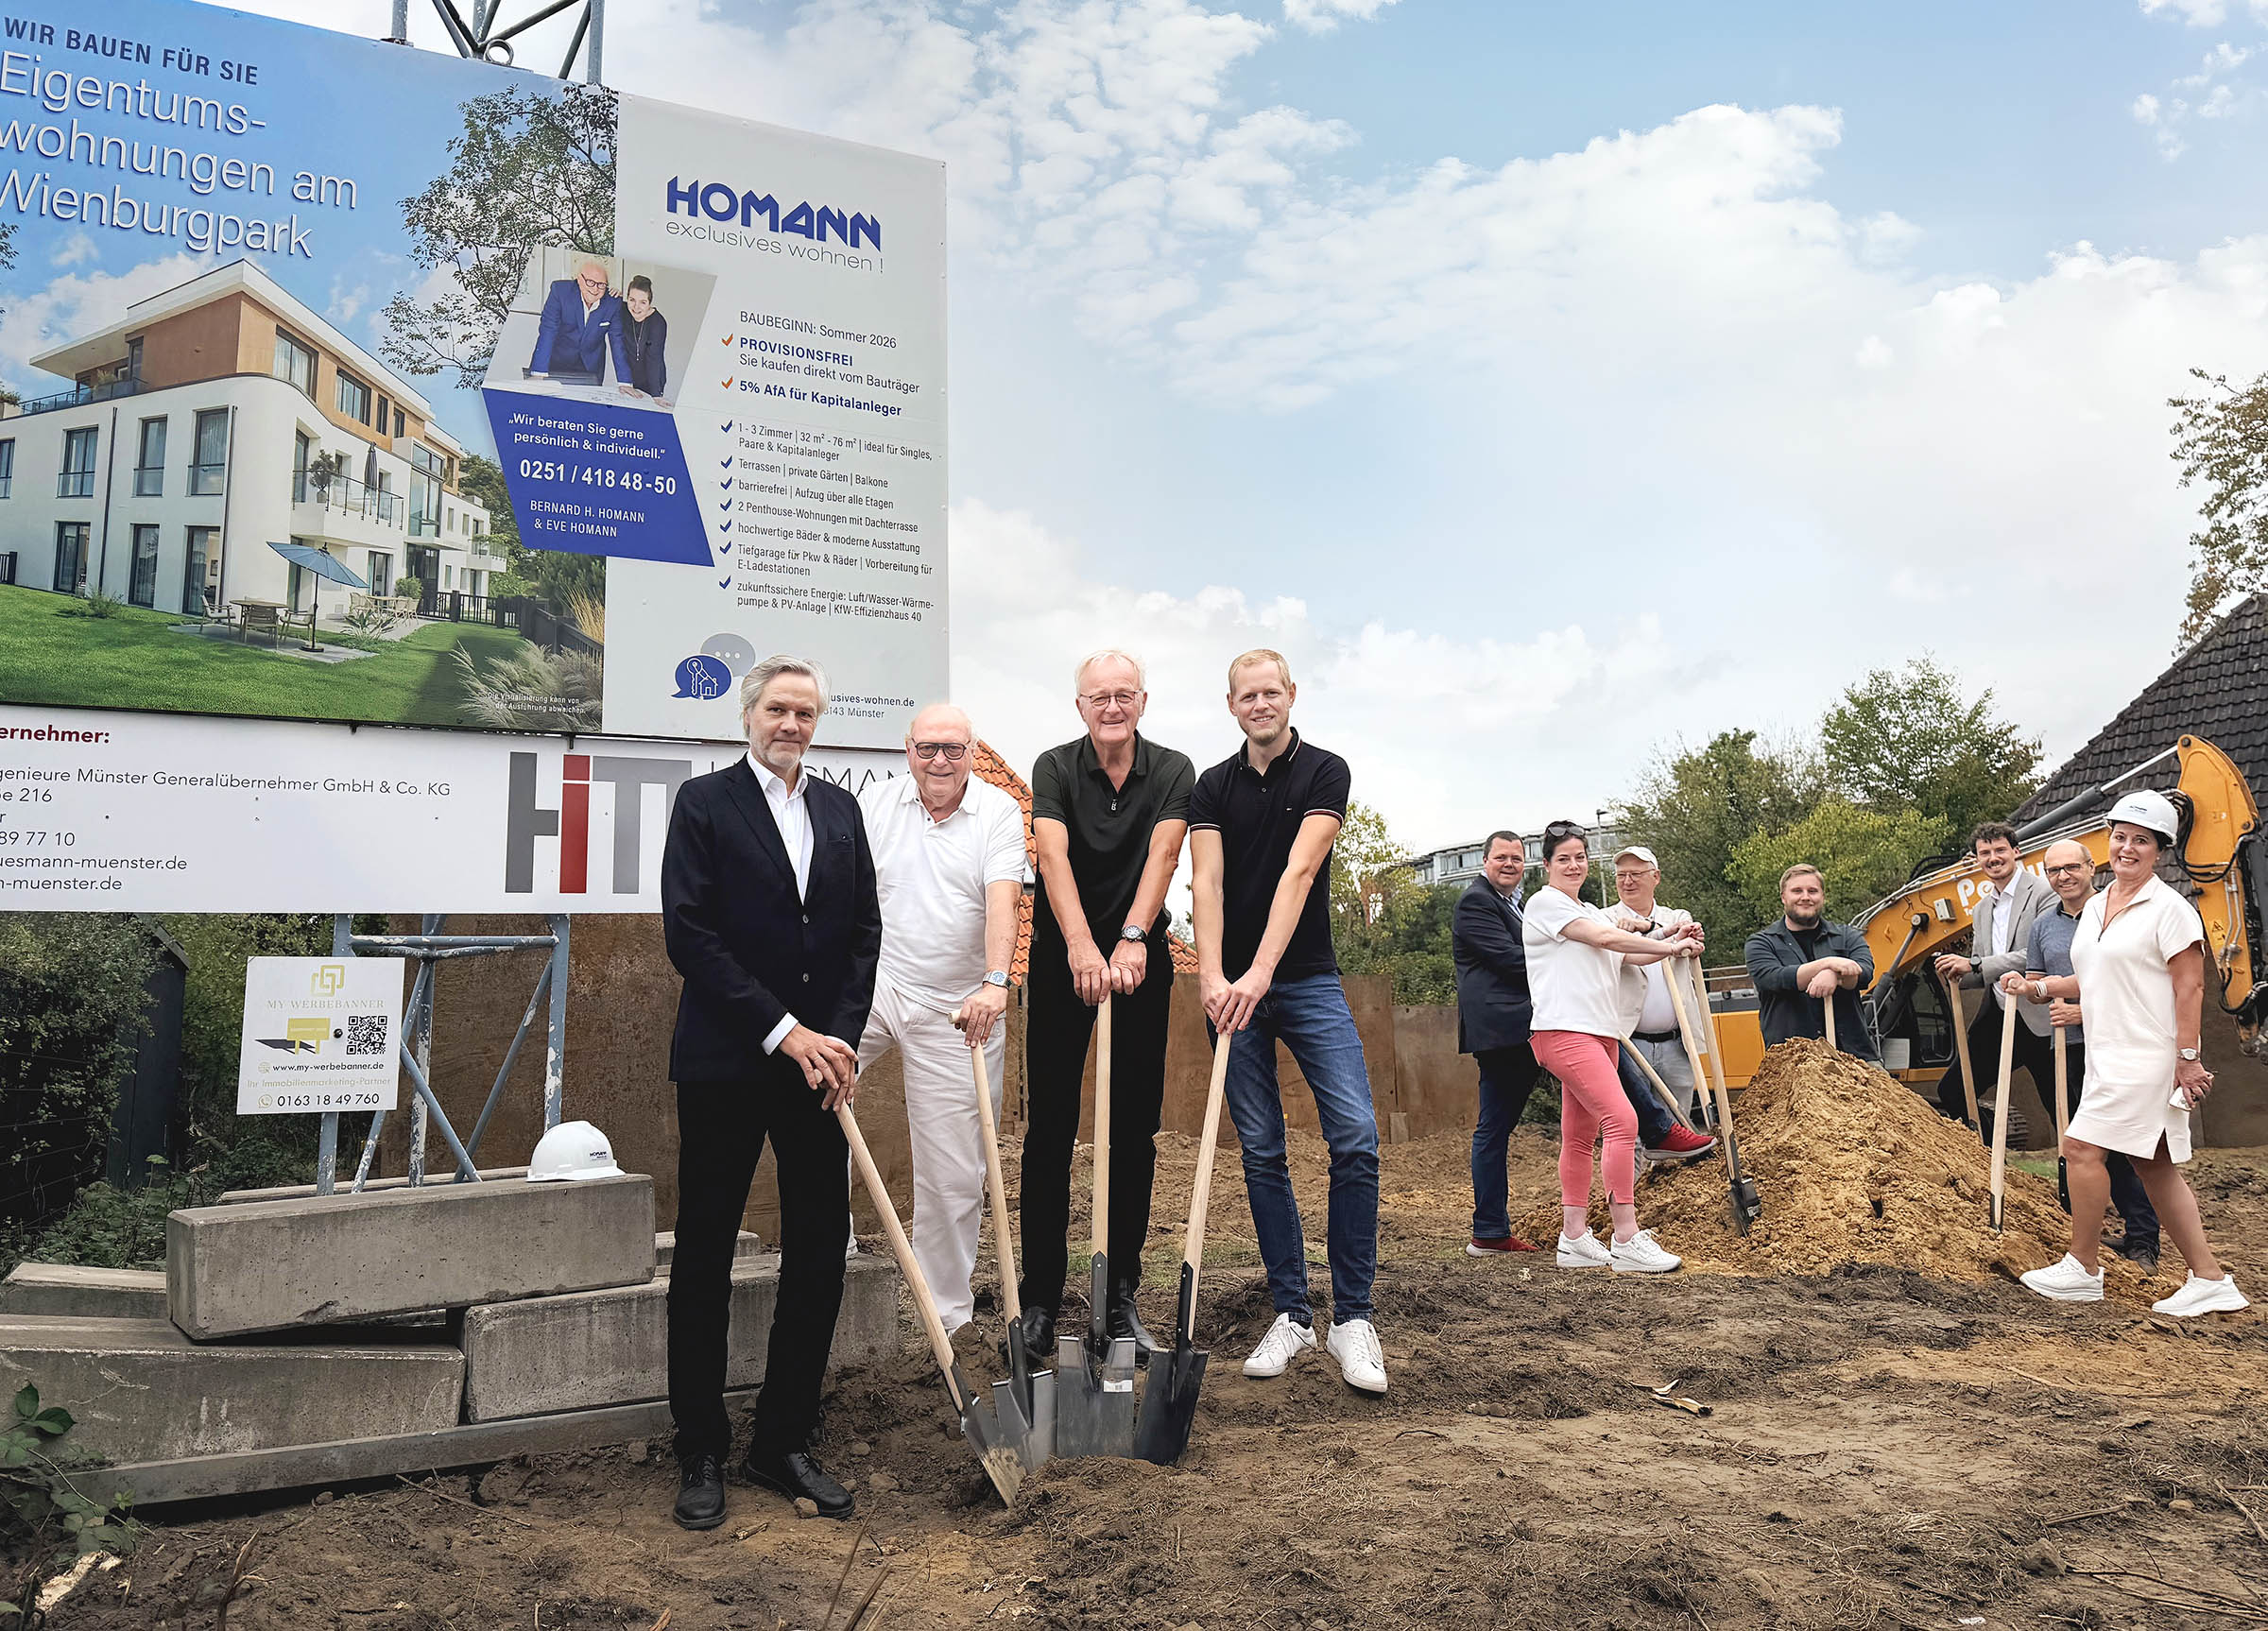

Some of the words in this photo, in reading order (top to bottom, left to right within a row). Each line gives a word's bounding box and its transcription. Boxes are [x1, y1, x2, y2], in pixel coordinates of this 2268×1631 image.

[5, 16, 54, 45] WIR
[66, 29, 151, 64] BAUEN
[163, 47, 210, 76] FÜR
[219, 60, 258, 85] SIE
[1, 50, 266, 135] Eigentums-
[0, 118, 274, 196] wohnungen
[292, 170, 357, 209] am
[0, 169, 312, 257] Wienburgpark
[667, 176, 881, 251] HOMANN
[665, 220, 782, 254] exclusives
[788, 244, 872, 271] wohnen
[740, 310, 816, 335] BAUBEGINN:
[819, 325, 867, 343] Sommer
[869, 334, 897, 349] 2026
[740, 337, 853, 366] PROVISIONSFREI
[740, 353, 758, 367] Sie
[762, 356, 800, 374] kaufen
[803, 364, 836, 381] direkt
[839, 371, 863, 385] vom
[867, 374, 920, 394] Bauträger
[740, 380, 760, 393] 5%
[764, 384, 786, 398] AfA
[789, 386, 808, 402] für
[811, 390, 902, 417] Kapitalanleger
[514, 432, 579, 449] persönlich
[583, 439, 593, 451] &
[538, 416, 584, 432] beraten
[588, 422, 606, 435] Sie
[610, 427, 644, 440] gerne
[739, 437, 765, 451] Paare
[766, 440, 774, 452] &
[777, 442, 840, 462] Kapitalanleger
[751, 424, 757, 435] 3
[759, 425, 793, 439] Zimmer
[800, 432, 811, 443] 32
[833, 436, 843, 447] 76
[864, 440, 885, 454] ideal
[886, 443, 898, 455] für
[900, 446, 933, 461] Singles,
[520, 459, 565, 483] 0251
[581, 466, 615, 489] 418
[739, 458, 781, 473] Terrassen
[788, 466, 817, 479] private
[820, 469, 849, 482] Gärten
[855, 474, 888, 488] Balkone
[738, 479, 788, 496] barrierefrei
[795, 487, 824, 503] Aufzug
[826, 490, 846, 505] über
[849, 494, 863, 506] alle
[866, 496, 894, 510] Etagen
[530, 500, 581, 516] BERNARD
[584, 506, 594, 518] H.
[598, 507, 644, 523] HOMANN
[738, 502, 744, 512] 2
[747, 502, 847, 524] Penthouse-Wohnungen
[850, 515, 863, 526] mit
[865, 516, 919, 533] Dachterrasse
[535, 518, 542, 529] &
[546, 520, 567, 532] EVE
[570, 522, 617, 538] HOMANN
[738, 522, 794, 540] hochwertige
[796, 528, 821, 542] Bäder
[823, 532, 831, 543] &
[833, 534, 869, 548] moderne
[872, 539, 920, 556] Ausstattung
[737, 559, 811, 576] E-Ladestationen
[738, 544, 786, 560] Tiefgarage
[787, 549, 800, 560] für
[802, 551, 821, 563] Pkw
[823, 553, 831, 564] &
[833, 555, 857, 567] Räder
[865, 558, 919, 575] Vorbereitung
[921, 563, 933, 575] für
[737, 581, 808, 598] zukunftssichere
[811, 588, 846, 602] Energie:
[849, 592, 935, 609] Luft/Wasser-Wärme-
[737, 596, 769, 609] pumpe
[771, 598, 779, 609] &
[782, 600, 827, 614] PV-Anlage
[834, 605, 909, 621] KfW-Effizienzhaus
[911, 611, 921, 622] 40
[501, 694, 547, 703] Visualisierung
[550, 695, 566, 703] kann
[508, 702, 546, 712] Ausführung
[831, 693, 915, 707] usives-wohnen.de
[848, 707, 885, 718] Münster
[0, 725, 110, 743] ernehmer:
[19, 788, 52, 802] 216
[77, 768, 148, 784] Münster
[153, 771, 318, 792] Generalübernehmer
[323, 778, 374, 794] GmbH
[379, 781, 391, 794] &
[396, 781, 422, 795] Co.
[427, 781, 451, 797] KG
[0, 831, 19, 845] 89
[26, 832, 46, 846] 77
[55, 833, 75, 846] 10
[267, 1000, 285, 1009] MY
[290, 1000, 384, 1009] WERBEBANNER
[273, 1062, 384, 1073] www.my-werbebanner.de
[248, 1079, 258, 1088] Ihr
[262, 1077, 390, 1088] Immobilienmarketing-Partner
[277, 1095, 310, 1107] 0163
[317, 1094, 331, 1105] 18
[335, 1093, 352, 1105] 49
[355, 1093, 379, 1105] 760
